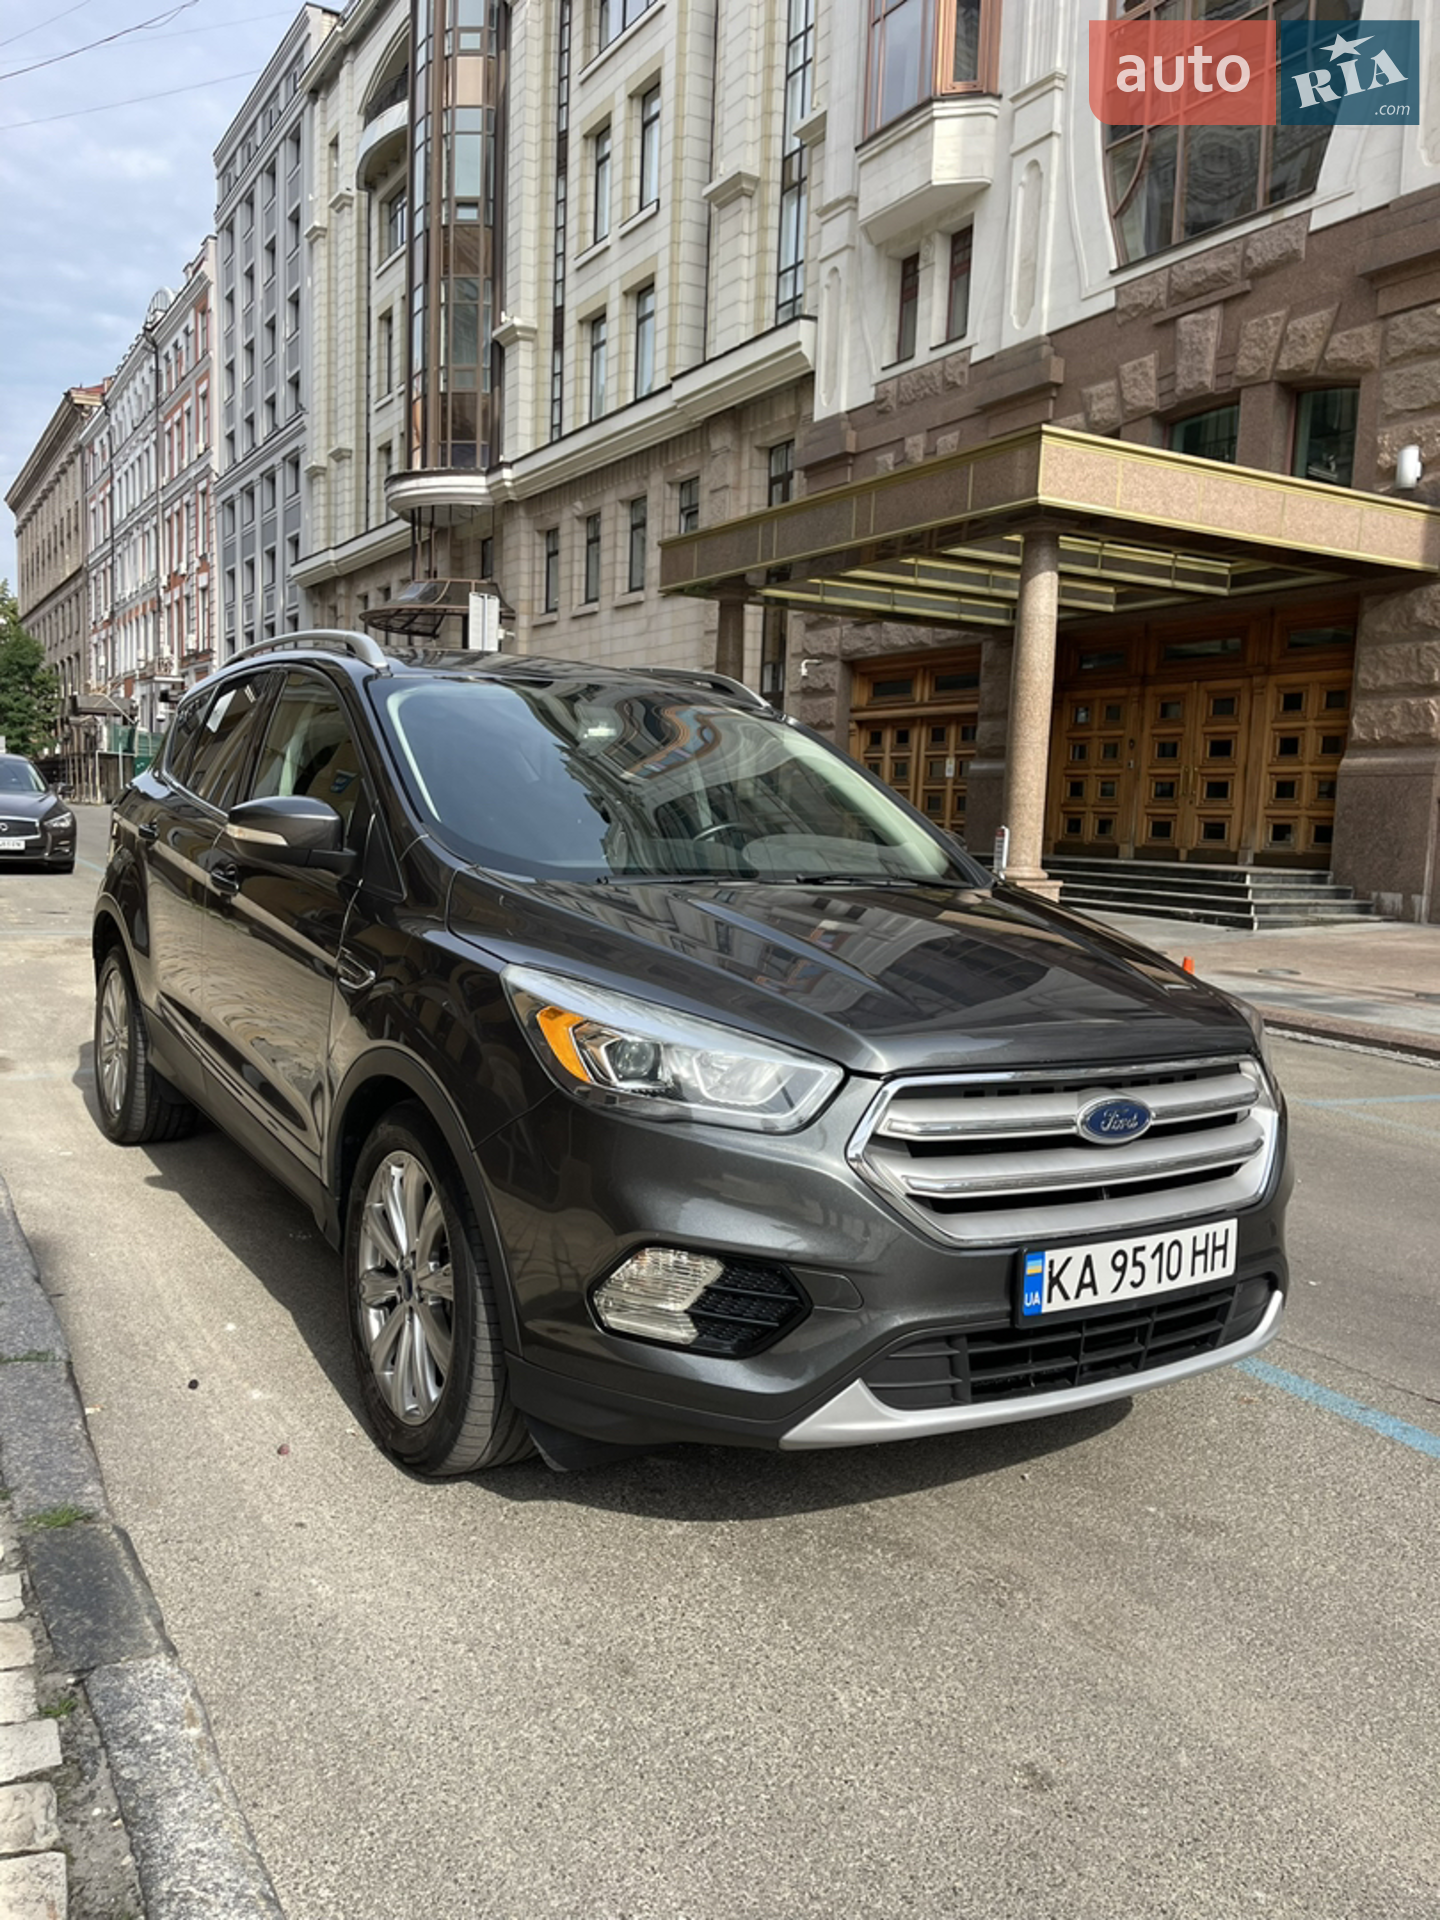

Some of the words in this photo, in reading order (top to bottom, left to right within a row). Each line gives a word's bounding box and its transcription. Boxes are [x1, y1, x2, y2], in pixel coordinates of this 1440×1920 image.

[1101, 1108, 1138, 1132] Ford
[1047, 1254, 1099, 1304] KA
[1110, 1239, 1182, 1294] 9510
[1191, 1228, 1229, 1277] HH
[1025, 1291, 1041, 1307] UA
